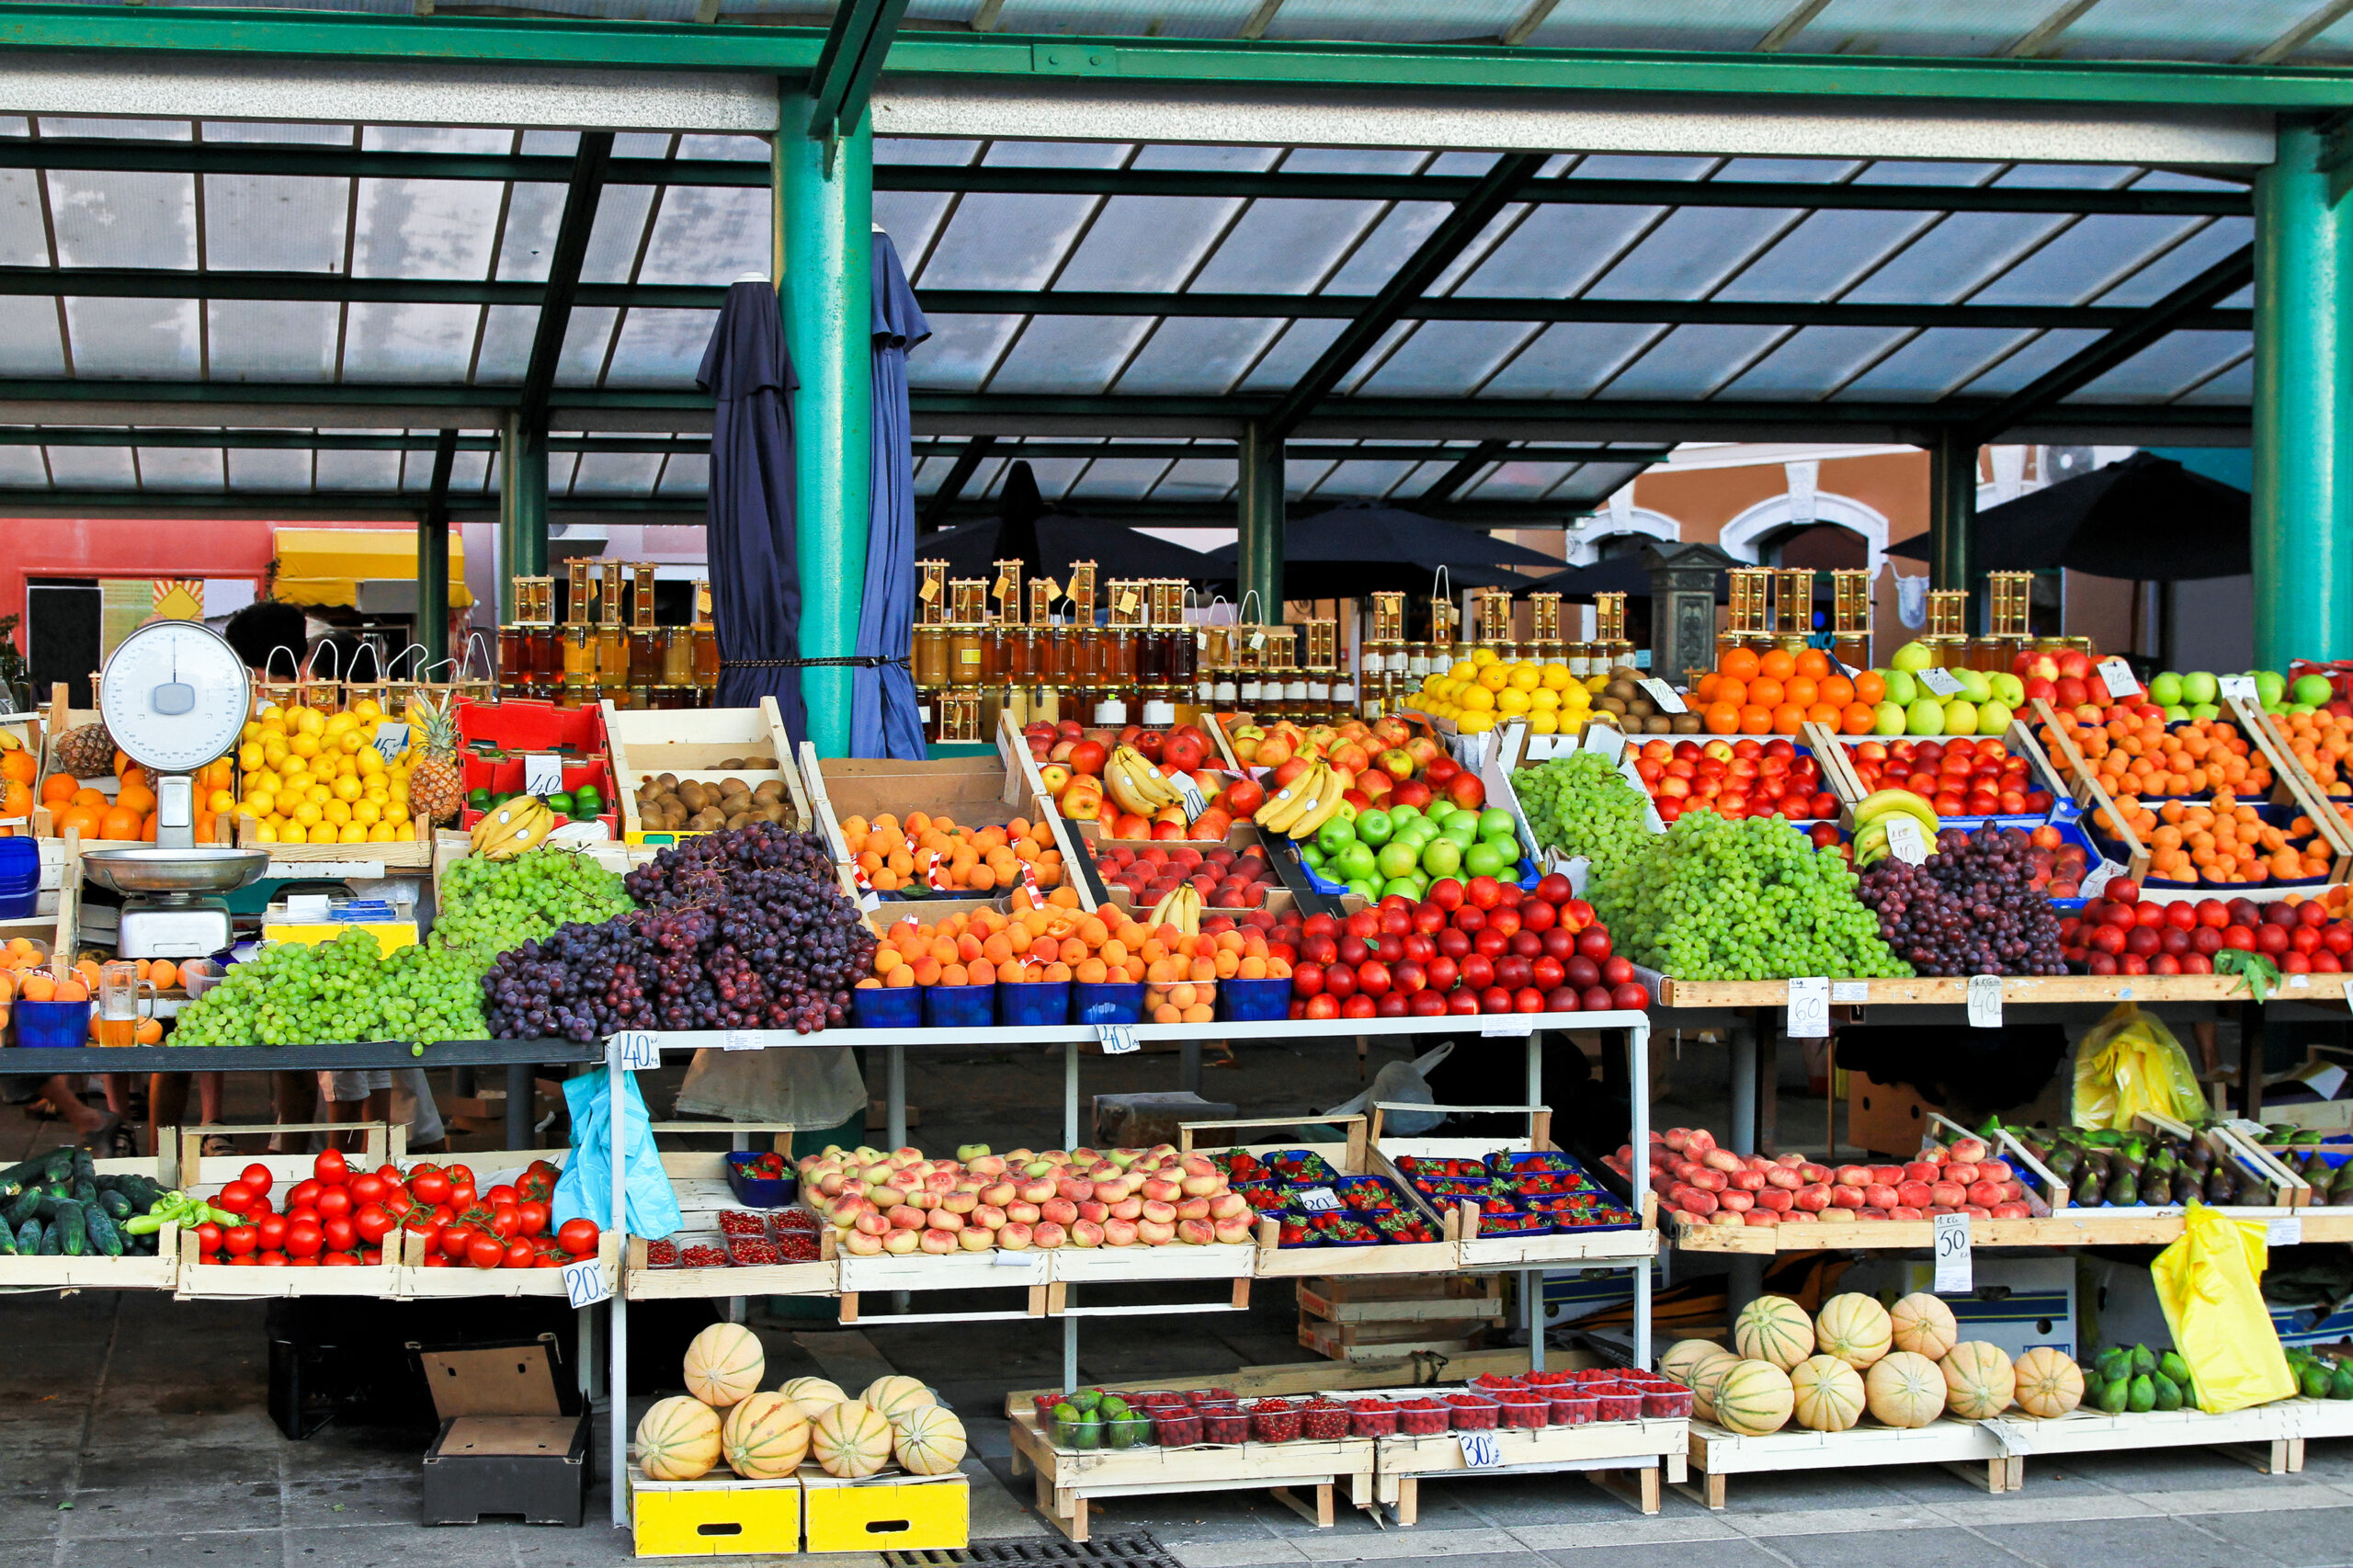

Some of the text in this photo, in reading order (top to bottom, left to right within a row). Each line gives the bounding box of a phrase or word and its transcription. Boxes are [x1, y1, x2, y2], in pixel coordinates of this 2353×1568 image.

[527, 773, 561, 795] 40
[1795, 997, 1821, 1021] 60
[1972, 988, 1996, 1020] 40
[623, 1032, 650, 1069] 40
[1103, 1025, 1131, 1051] 40
[1940, 1229, 1965, 1257] 50
[566, 1267, 599, 1307] 20
[1461, 1436, 1490, 1467] 30
